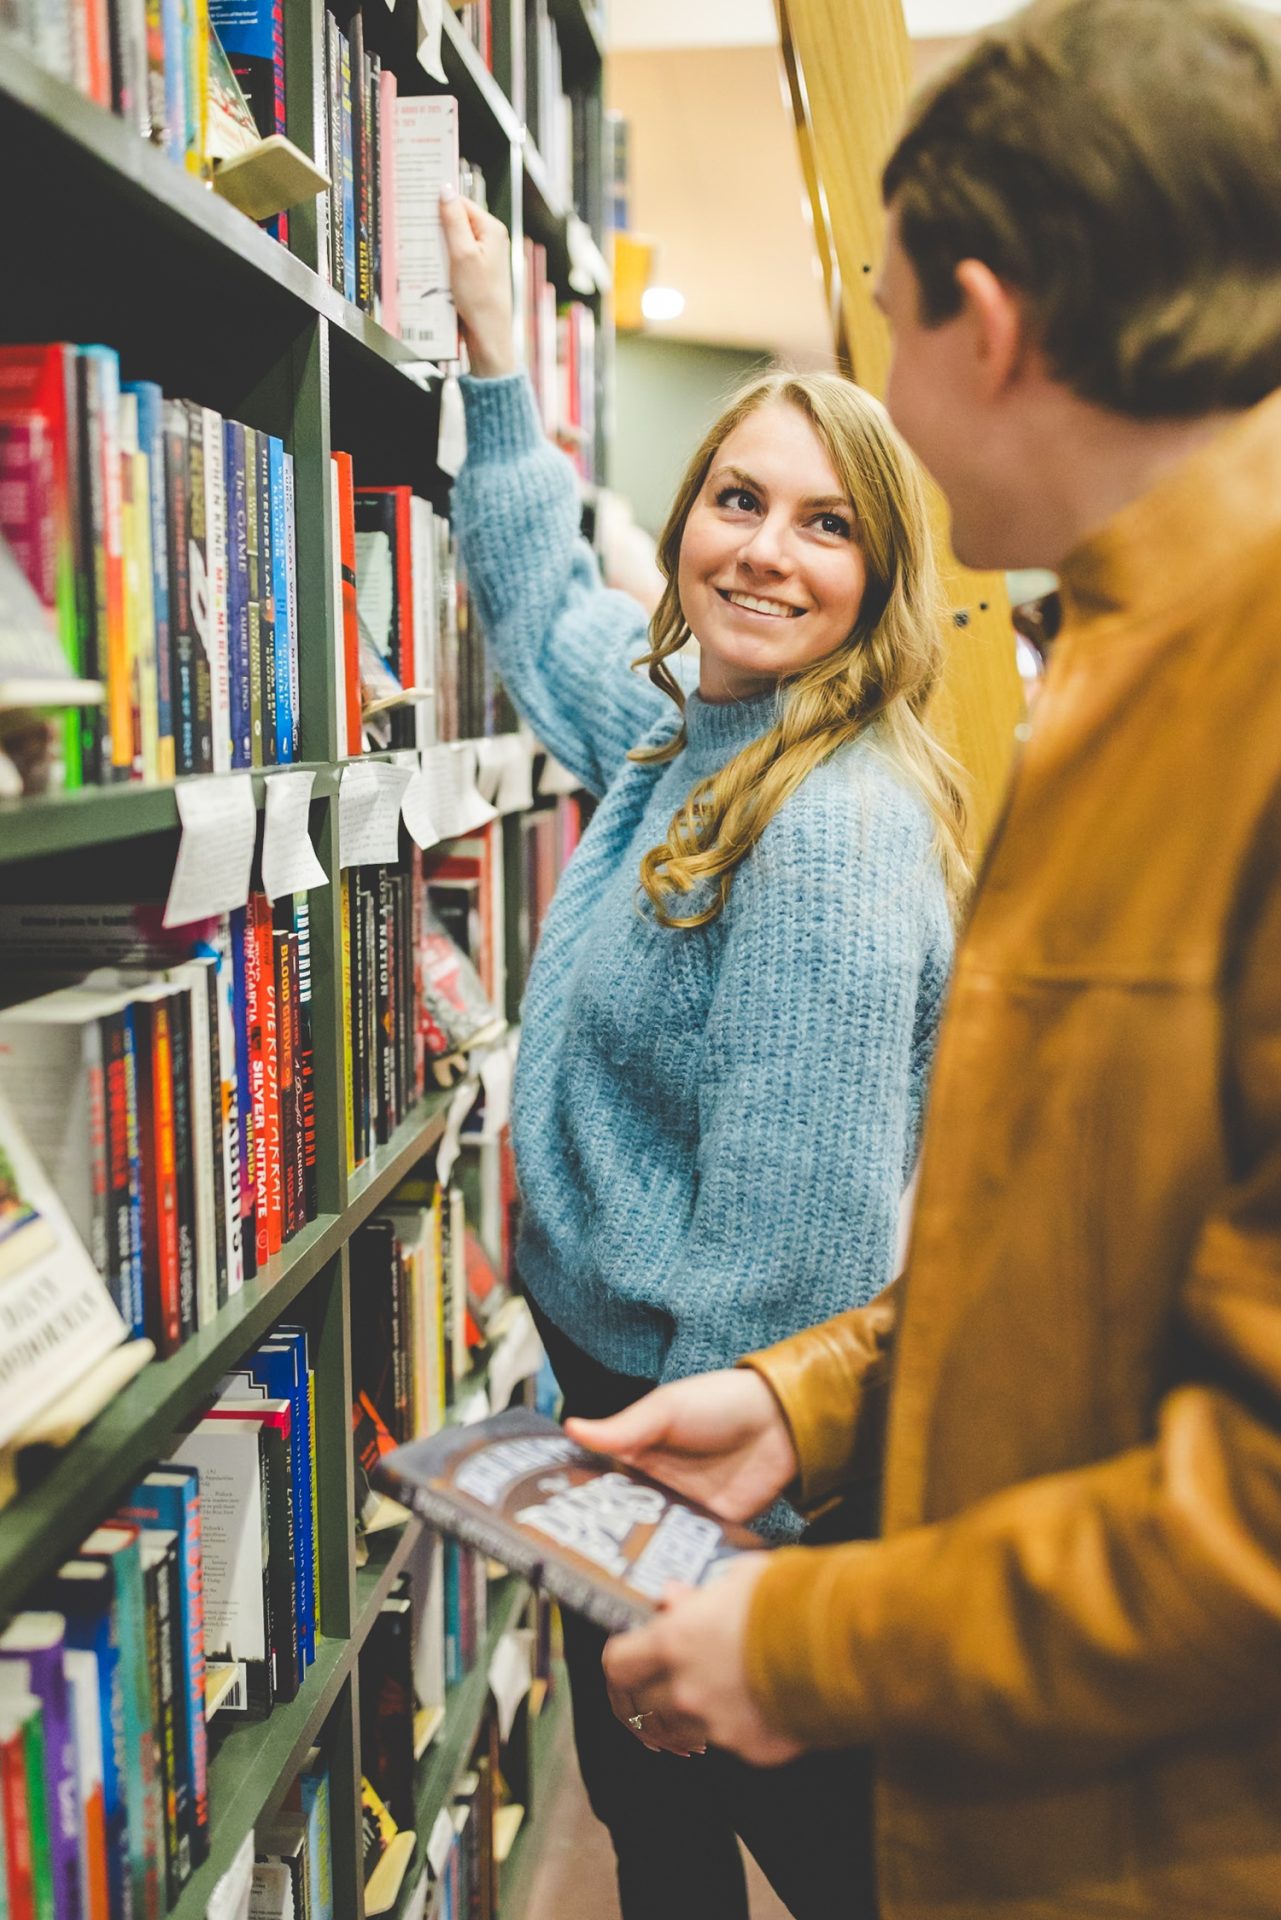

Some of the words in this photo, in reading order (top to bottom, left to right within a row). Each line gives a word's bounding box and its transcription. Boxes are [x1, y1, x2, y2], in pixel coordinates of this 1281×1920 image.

[360, 240, 370, 301] ELLIOTT
[236, 469, 245, 502] The
[214, 513, 224, 558] KING
[237, 510, 247, 574] GAME
[240, 606, 248, 652] LAURIE
[241, 675, 249, 711] KING
[379, 869, 388, 918] LOST
[246, 903, 258, 1023] MORENO-GARCIA
[280, 944, 289, 1002] BLOOD
[297, 903, 312, 1003] DROWNING
[379, 924, 389, 997] NATION
[282, 1004, 291, 1063] GROVE
[252, 1060, 265, 1129] SILVER
[246, 1113, 255, 1185] MIRANDA
[304, 1091, 316, 1167] NEWMAN
[256, 1137, 268, 1219] NITRATE
[296, 1131, 304, 1198] SPLENDOR
[287, 1166, 295, 1232] MOSLEY
[287, 1488, 296, 1568] LATINIST
